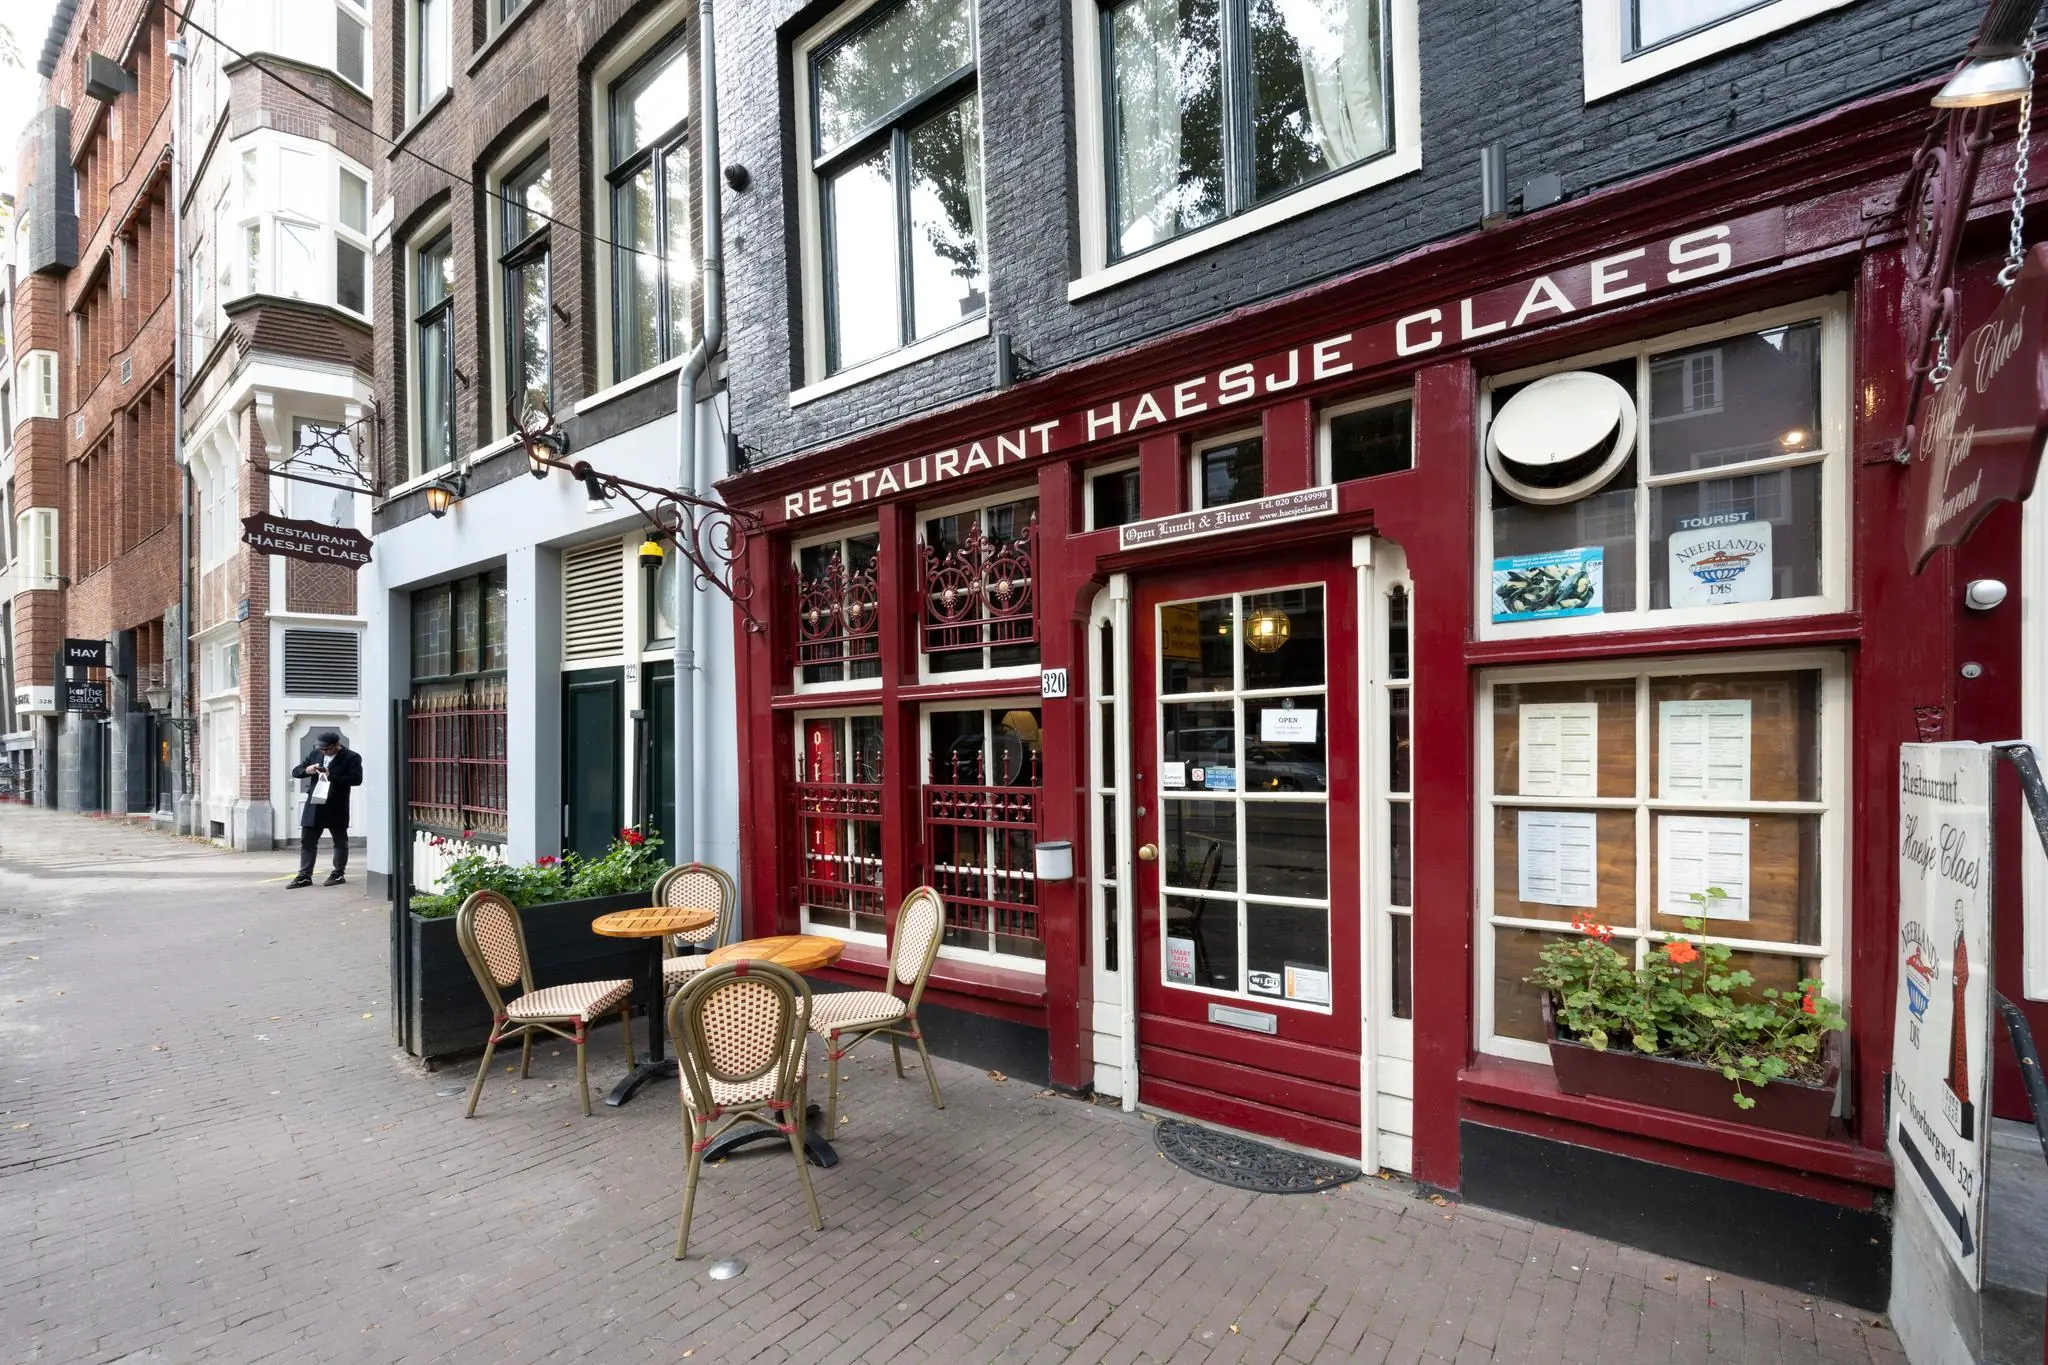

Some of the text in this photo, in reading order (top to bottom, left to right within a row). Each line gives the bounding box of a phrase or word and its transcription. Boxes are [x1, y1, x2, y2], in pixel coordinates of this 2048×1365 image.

[785, 225, 1732, 519] RESTAURANT HAESJE CLAES
[1259, 490, 1328, 510] Tel. 020 6249998
[1259, 501, 1328, 520] www.haesjeclaes.nl
[1126, 511, 1251, 542] Open Lunch & Diner
[1680, 512, 1749, 528] TOURIST
[248, 533, 369, 562] HAESJE CLAES
[263, 523, 358, 548] RESTAURANT
[1675, 539, 1766, 563] NEERLANDS
[1710, 583, 1732, 595] DIS
[71, 648, 98, 657] HAY
[1043, 672, 1065, 693] 320
[69, 695, 103, 704] salon
[1902, 761, 1958, 804] Restaurant
[1902, 814, 1981, 890] Haesje Claes
[1901, 920, 1940, 980] NEERLANDS
[1909, 1019, 1920, 1050] DIS
[1908, 1091, 1955, 1176] Voorburgwal
[1957, 1161, 1973, 1198] 320
